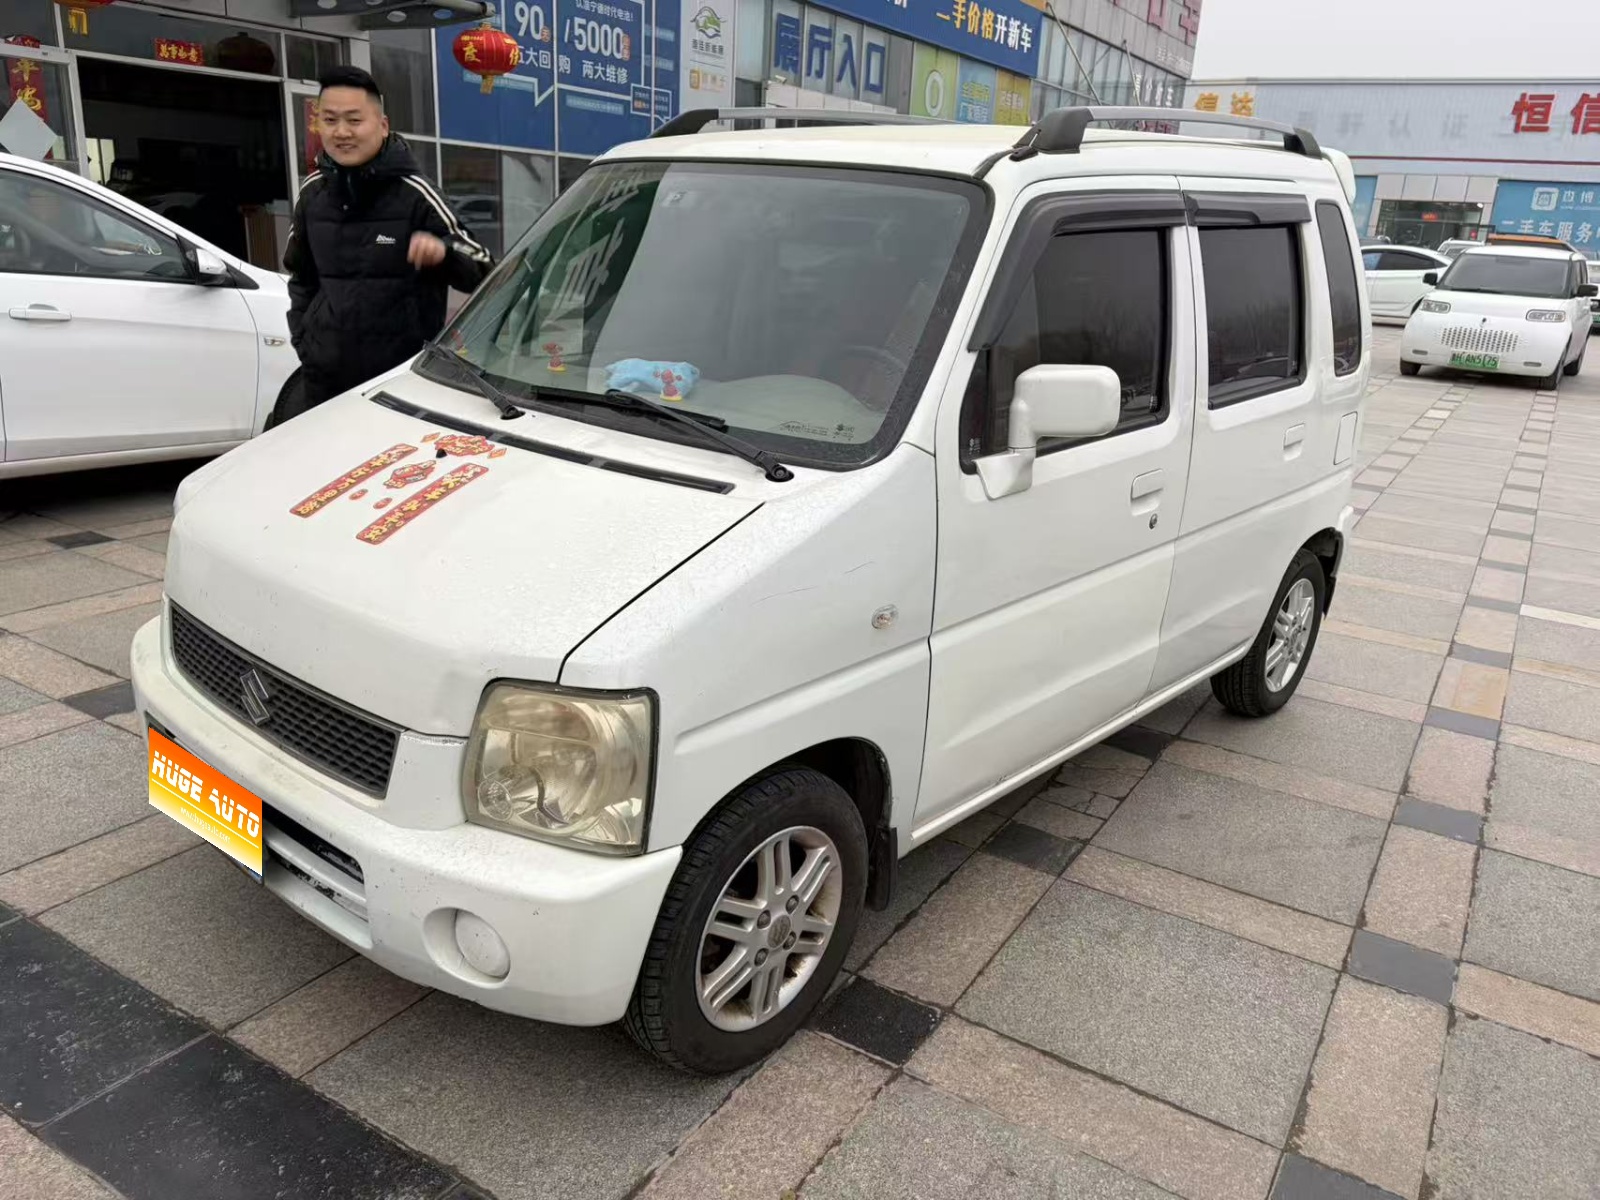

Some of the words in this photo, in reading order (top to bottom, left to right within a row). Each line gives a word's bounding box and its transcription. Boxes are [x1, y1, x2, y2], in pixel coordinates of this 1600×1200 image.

[582, 60, 629, 85] 两大维修
[774, 12, 886, 95] 展厅入口
[1511, 92, 1600, 135] 恒信
